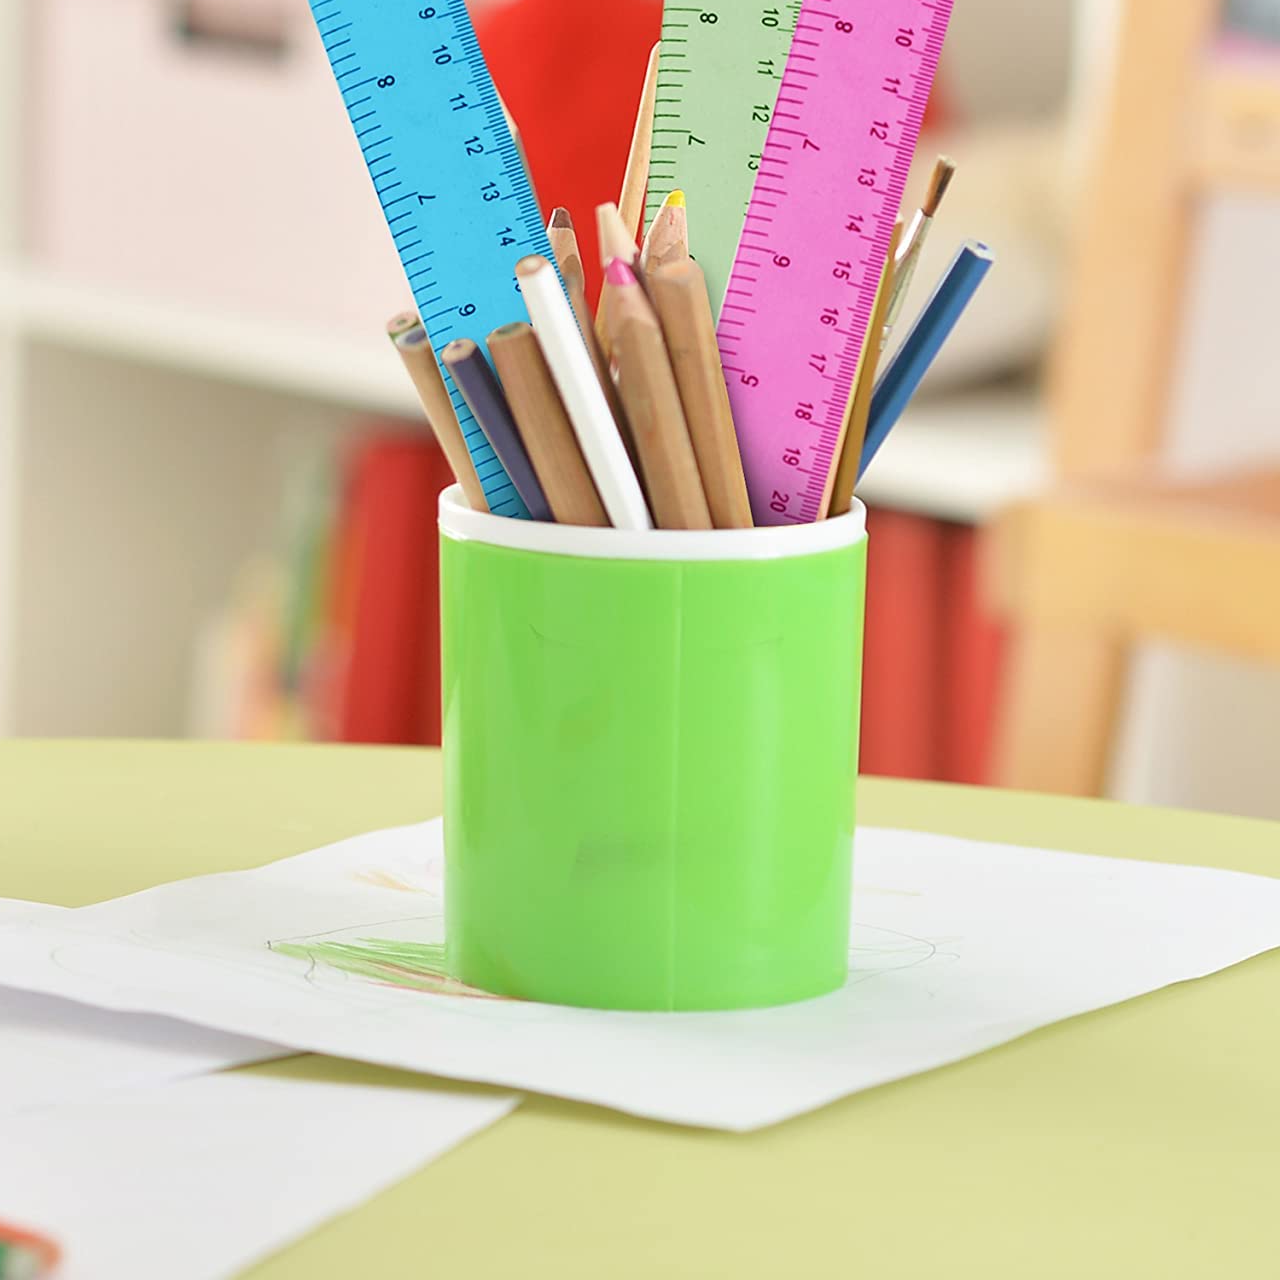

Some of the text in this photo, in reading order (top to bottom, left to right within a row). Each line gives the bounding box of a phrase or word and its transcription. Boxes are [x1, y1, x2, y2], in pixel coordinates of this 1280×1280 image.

[761, 8, 780, 28] 10
[894, 28, 915, 48] 10
[757, 59, 775, 76] 11
[376, 74, 396, 89] 8
[687, 134, 706, 146] 7
[699, 12, 719, 25] 8
[882, 77, 902, 94] 11
[752, 104, 770, 123] 12
[418, 6, 436, 20] 9
[432, 44, 452, 66] 10
[449, 93, 469, 112] 11
[464, 135, 484, 157] 12
[480, 181, 501, 202] 13
[496, 226, 517, 247] 14
[869, 120, 890, 141] 12
[857, 168, 877, 187] 13
[417, 194, 436, 206] 7
[740, 374, 759, 388] 5
[772, 254, 791, 268] 6
[802, 138, 821, 151] 7
[834, 20, 854, 34] 8
[845, 215, 864, 233] 14
[832, 260, 852, 281] 15
[458, 303, 477, 317] 6
[819, 308, 840, 327] 16
[808, 354, 827, 374] 17
[794, 402, 814, 421] 18
[782, 448, 801, 467] 19
[768, 490, 790, 513] 20
